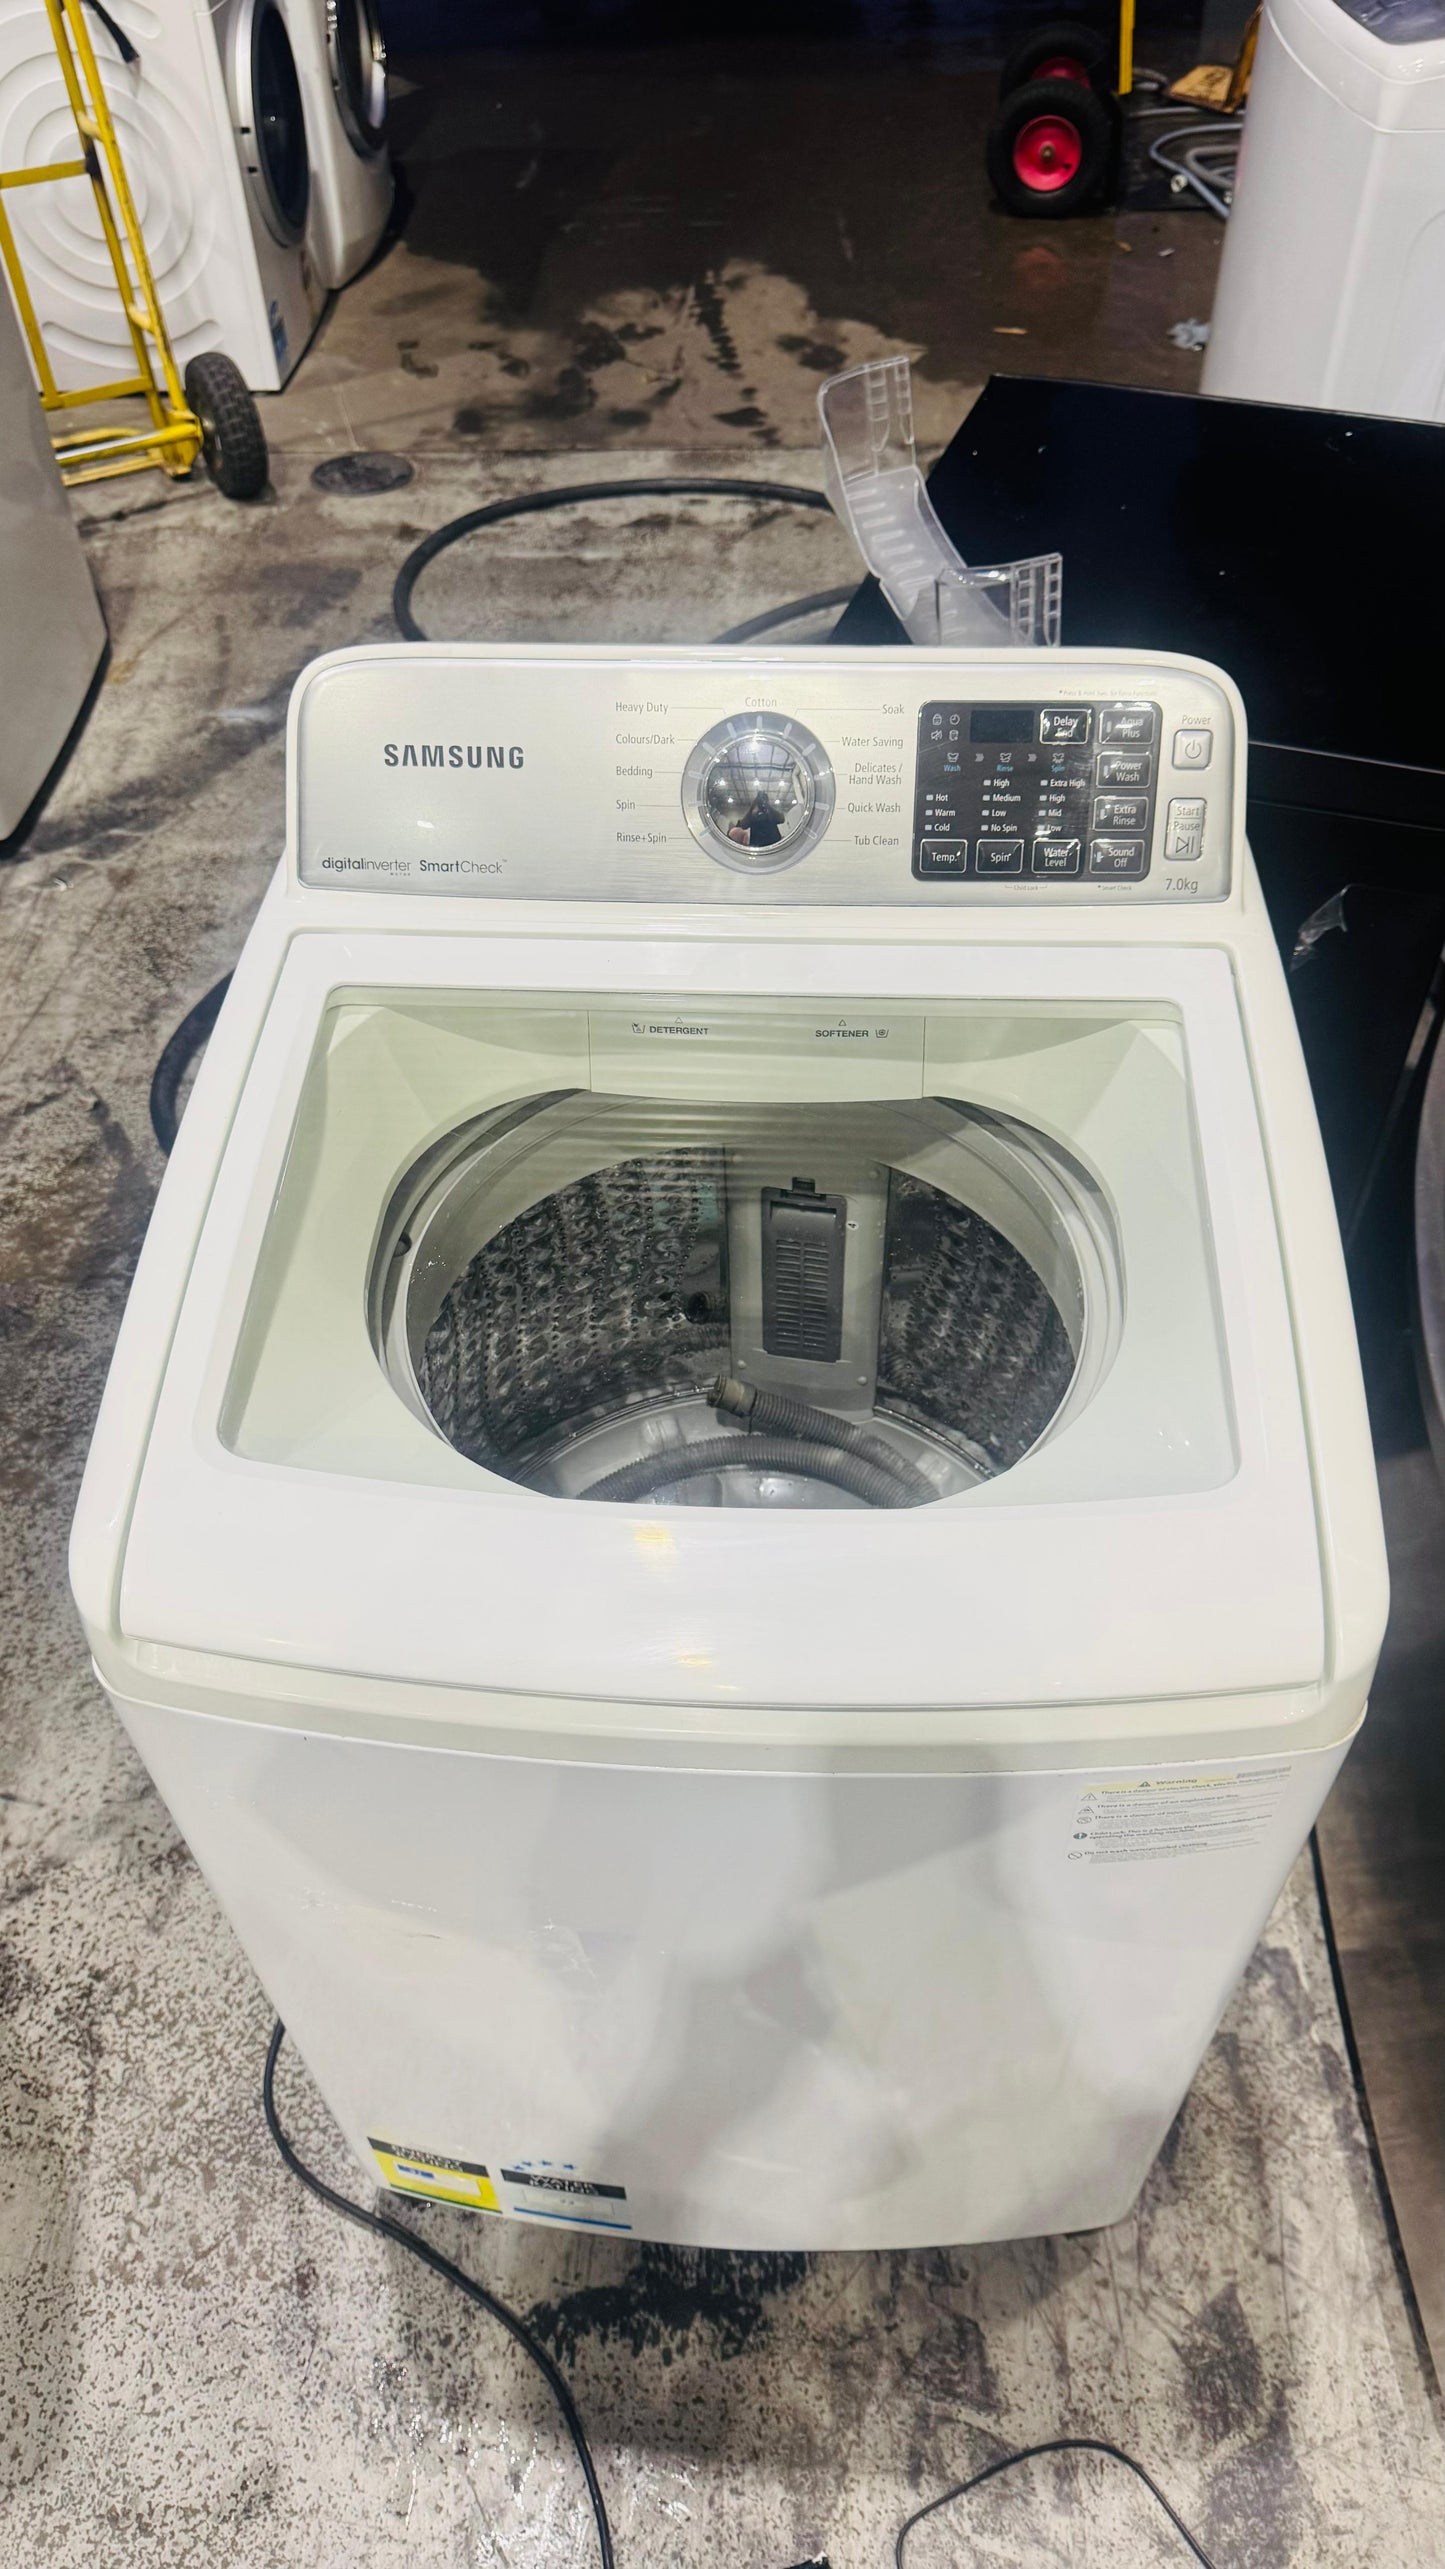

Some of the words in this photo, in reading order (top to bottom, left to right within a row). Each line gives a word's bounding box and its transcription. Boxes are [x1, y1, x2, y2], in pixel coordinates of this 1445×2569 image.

[745, 697, 777, 708] Cotton
[615, 702, 644, 714] Heavy
[646, 703, 669, 714] Duty
[882, 704, 905, 715] Soak
[1053, 716, 1078, 728] Delay
[1121, 717, 1144, 728] Aqua
[1181, 715, 1211, 725] Power
[1055, 727, 1073, 738] End
[1122, 729, 1140, 738] Plus
[616, 733, 675, 745] Colours/Dark
[841, 736, 871, 747] Water
[873, 736, 904, 749] Saving
[384, 743, 525, 769] SAMSUNG
[855, 762, 896, 774] Delicates
[943, 764, 961, 772] Wash
[996, 764, 1014, 772] Rinse
[1051, 764, 1065, 773] Spin
[1116, 761, 1142, 771] Power
[616, 765, 653, 778] Bedding
[849, 775, 873, 785] Hand
[875, 775, 902, 785] Wash
[1116, 772, 1140, 782] Wash
[993, 779, 1010, 788] High
[1050, 779, 1068, 787] Extra
[1069, 779, 1086, 788] High
[935, 794, 949, 802] Hot
[992, 794, 1021, 802] Medium
[1049, 794, 1066, 804] High
[616, 800, 636, 812] Spin
[847, 803, 872, 814] Quick
[875, 803, 901, 813] Wash
[1114, 805, 1136, 814] Extra
[1176, 806, 1200, 816] Start
[934, 809, 956, 817] Warm
[991, 809, 1007, 817] Low
[1048, 809, 1062, 817] Mid
[1113, 816, 1136, 826] Rinse
[934, 824, 951, 832] Cold
[990, 824, 1001, 832] No
[1002, 824, 1018, 834] Spin
[1047, 824, 1062, 832] Low
[1174, 821, 1200, 832] Pause
[616, 832, 667, 845] Rinse+Spin
[854, 835, 871, 846] Tub
[873, 835, 900, 846] Clean
[1044, 847, 1069, 858] Water
[1108, 847, 1135, 857] Sound
[932, 852, 958, 864] Temp.
[990, 852, 1010, 863] Spin
[1045, 858, 1067, 867] Level
[1114, 858, 1128, 868] Off
[1165, 878, 1198, 894] 7.0kg
[649, 1025, 709, 1036] DETERGENT
[815, 1029, 869, 1038] SOFTENER
